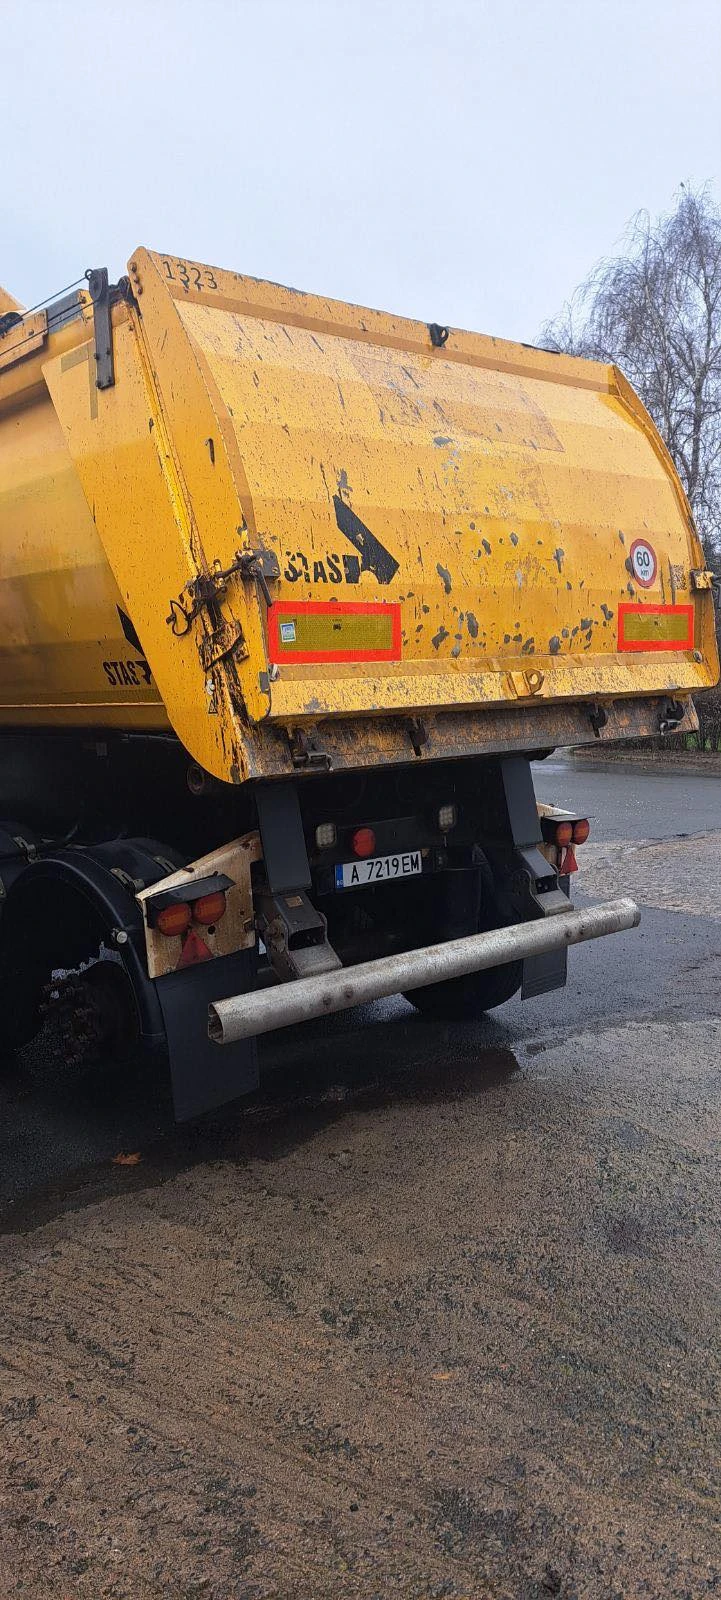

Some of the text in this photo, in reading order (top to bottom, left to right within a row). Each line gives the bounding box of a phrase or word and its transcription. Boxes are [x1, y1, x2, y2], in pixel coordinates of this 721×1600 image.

[162, 260, 218, 290] 1323
[283, 550, 343, 584] STAS
[636, 551, 650, 567] 60
[640, 569, 650, 577] km
[102, 660, 141, 686] STAS
[350, 864, 360, 884] A
